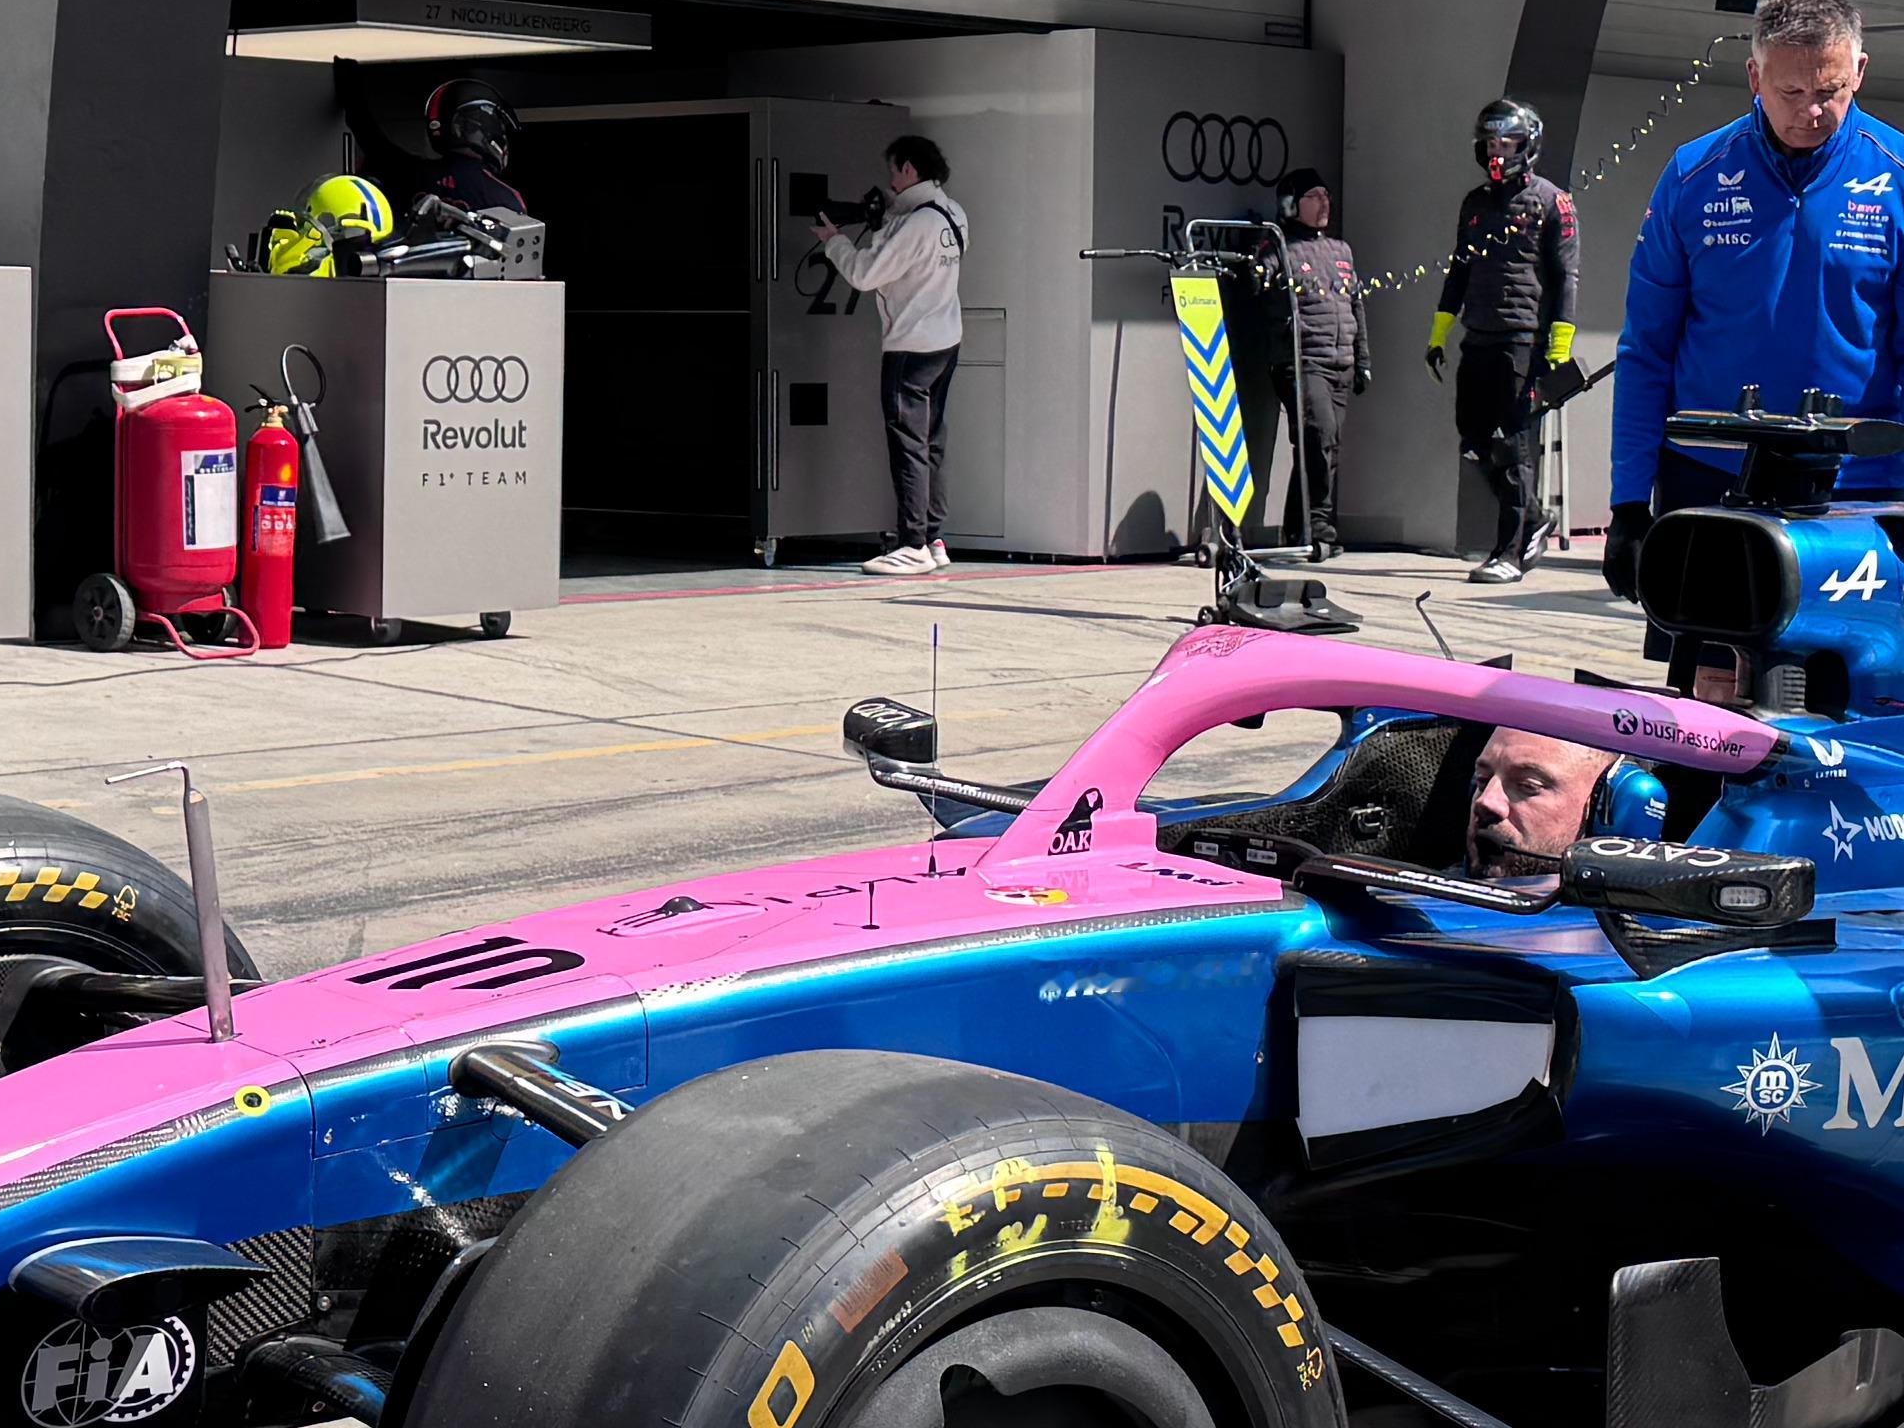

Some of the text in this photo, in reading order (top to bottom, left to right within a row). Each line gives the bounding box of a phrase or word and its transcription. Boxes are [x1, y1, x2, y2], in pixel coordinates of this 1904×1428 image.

[422, 418, 528, 451] Revolut
[466, 471, 528, 486] TEAM
[1049, 829, 1092, 856] OAK
